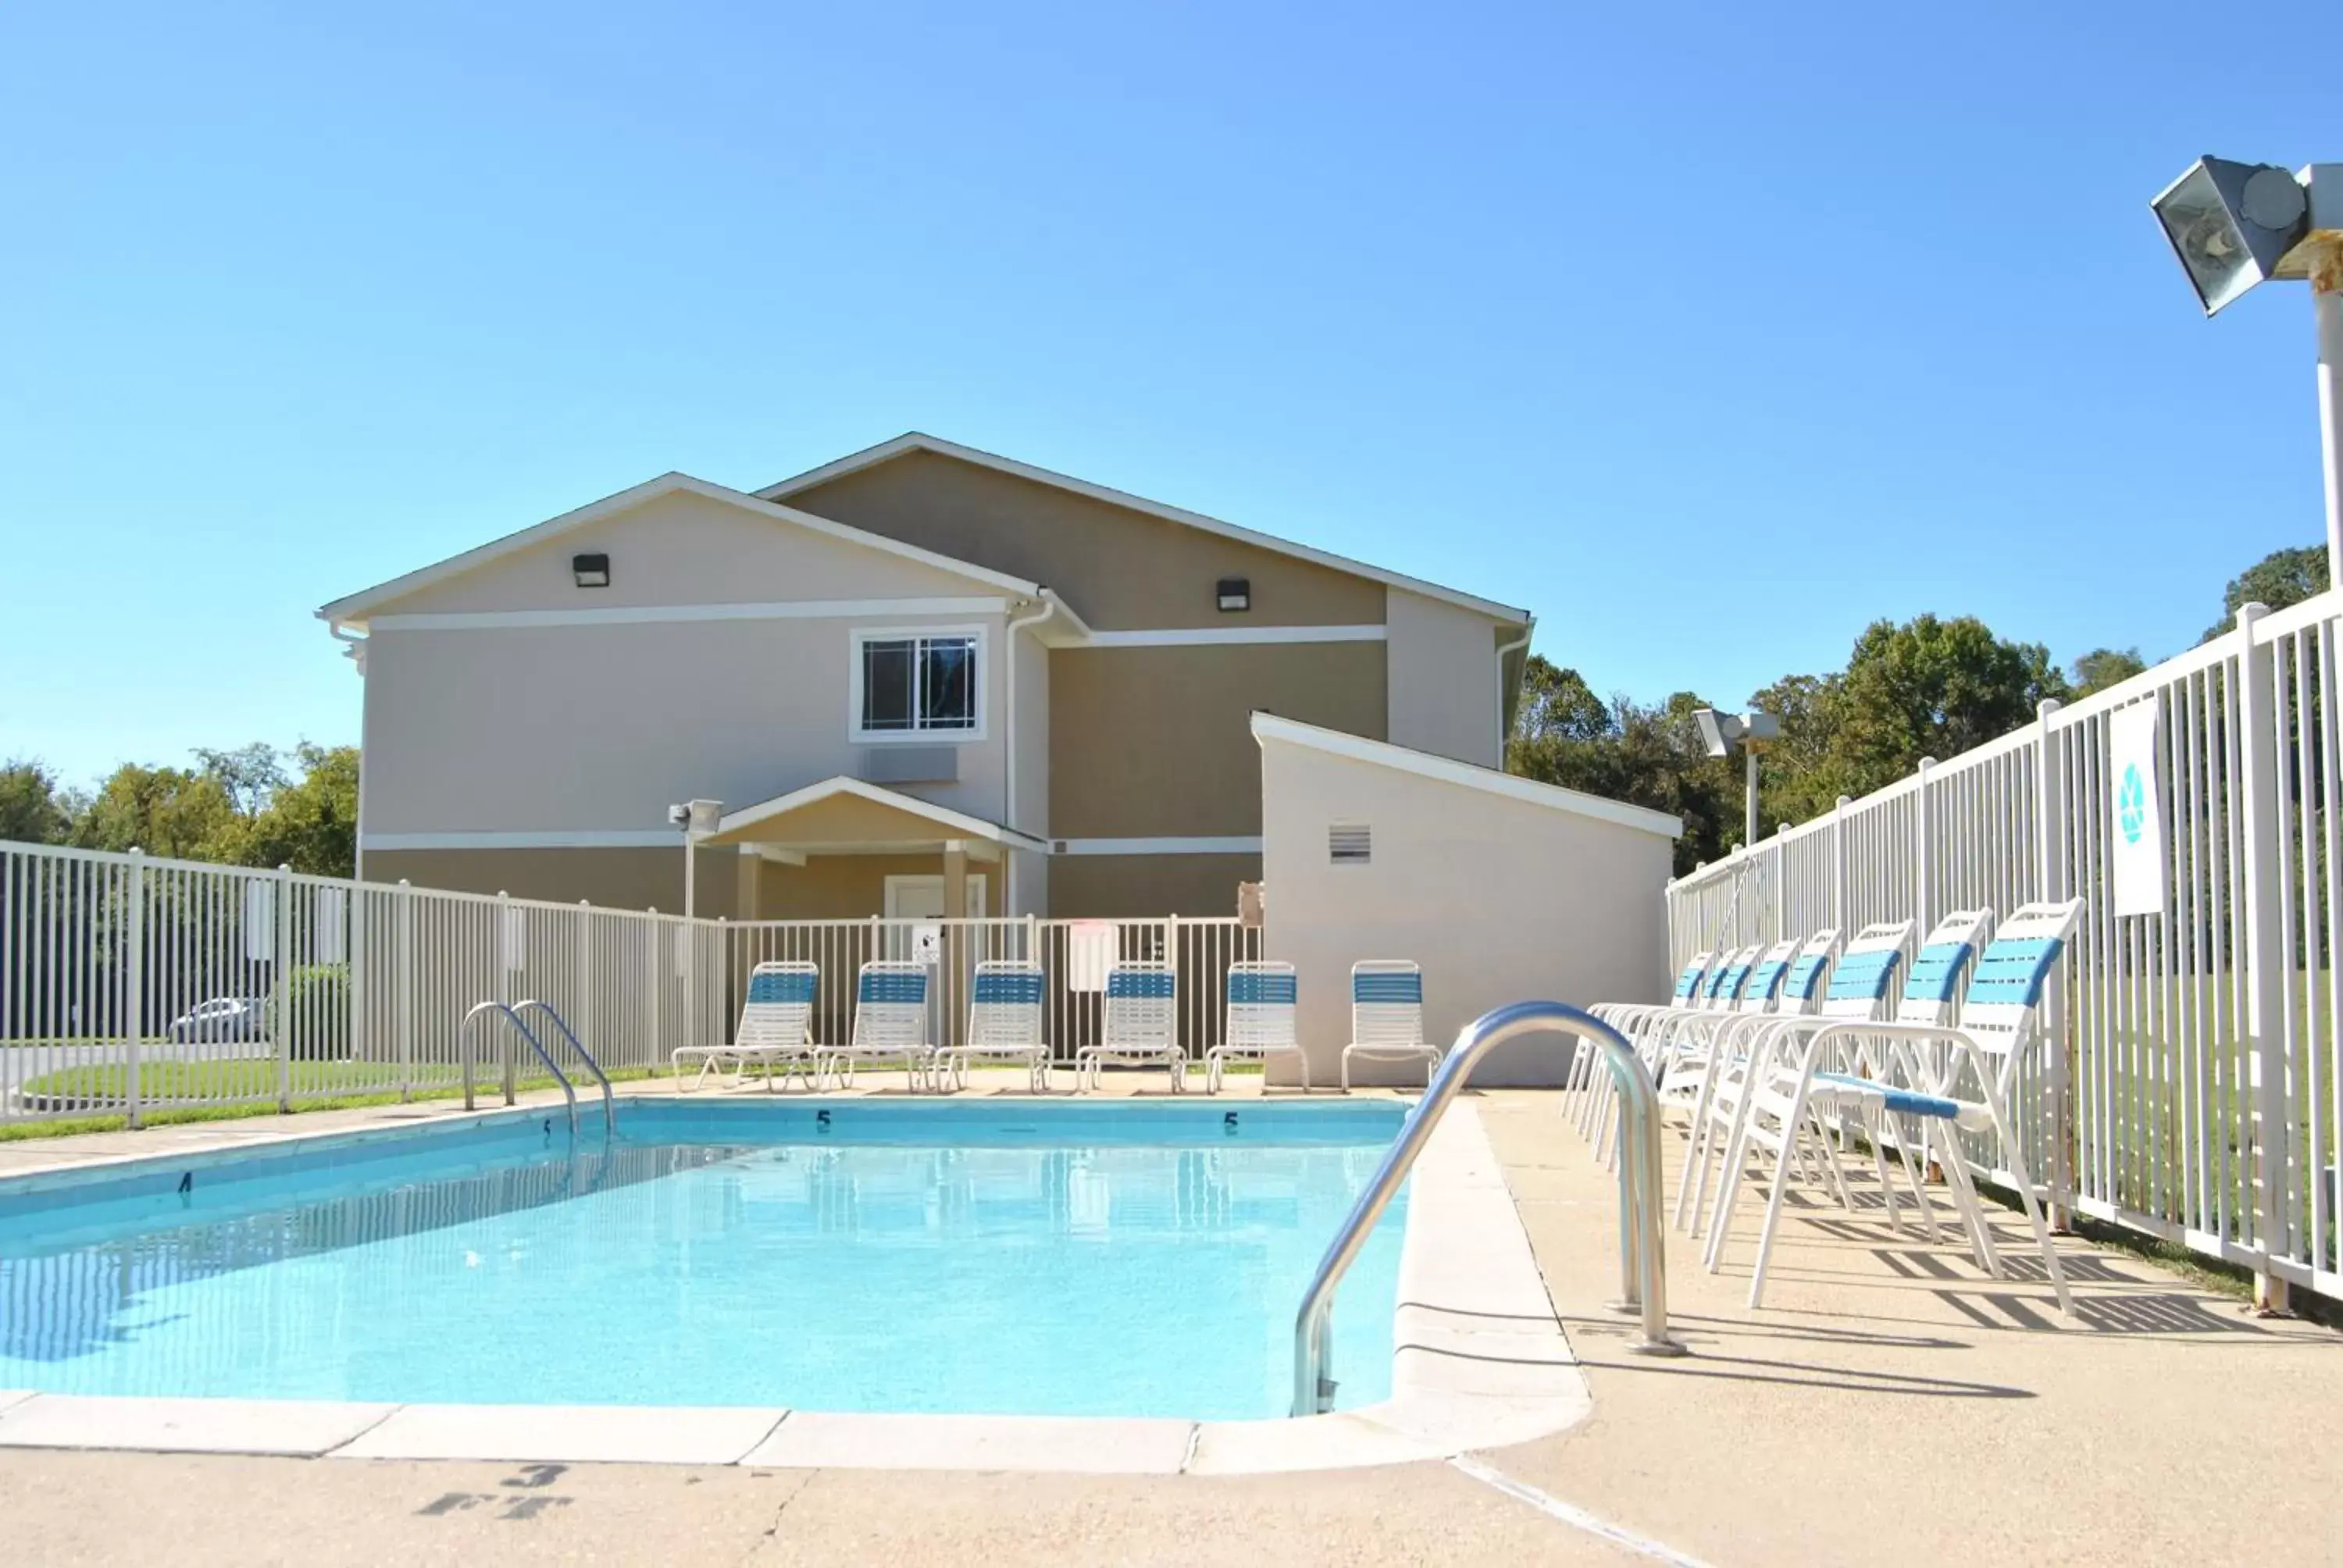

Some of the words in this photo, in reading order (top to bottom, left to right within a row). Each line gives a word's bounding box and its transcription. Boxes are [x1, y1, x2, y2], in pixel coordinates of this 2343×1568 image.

[818, 1109, 830, 1124] 5
[1225, 1111, 1238, 1126] 5
[500, 1463, 569, 1488] 3
